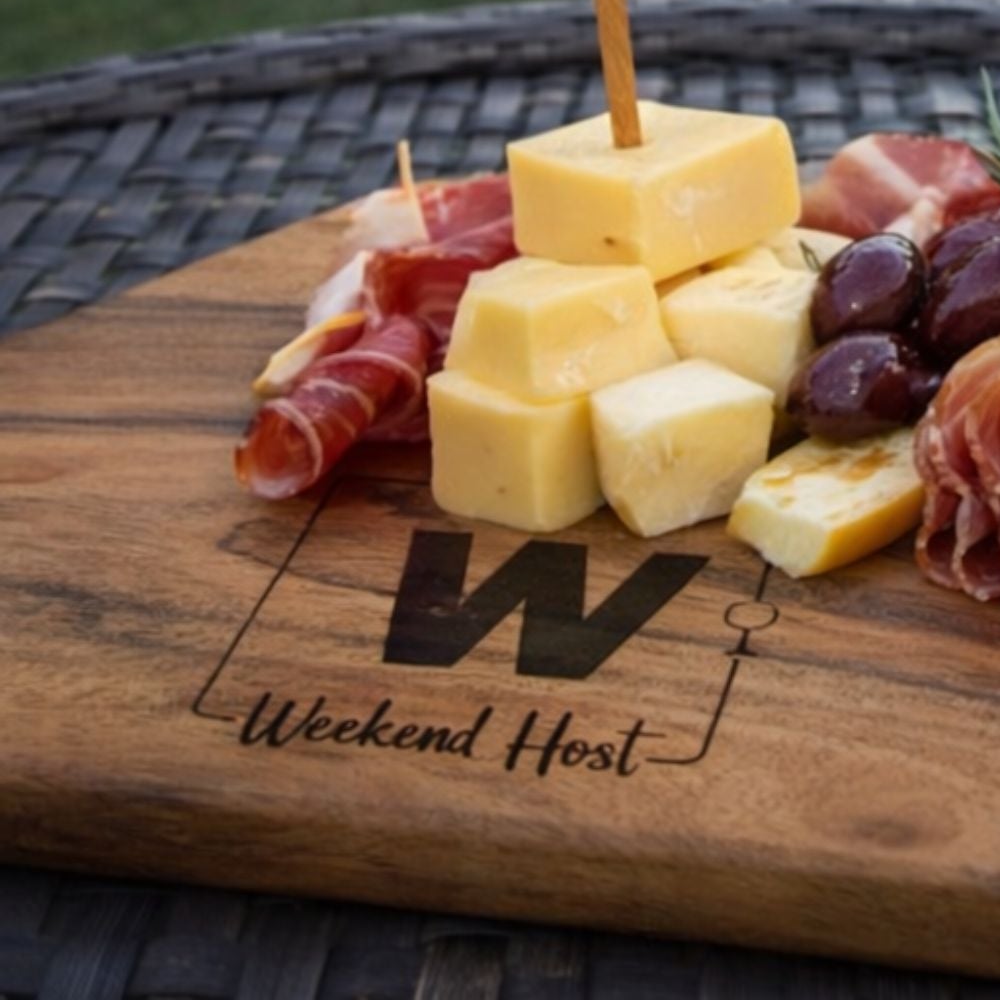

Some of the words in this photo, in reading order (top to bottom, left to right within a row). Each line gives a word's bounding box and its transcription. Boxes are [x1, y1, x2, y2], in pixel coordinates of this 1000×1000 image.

[382, 528, 711, 680] W
[238, 691, 493, 759] Weekend
[505, 706, 666, 777] Host
